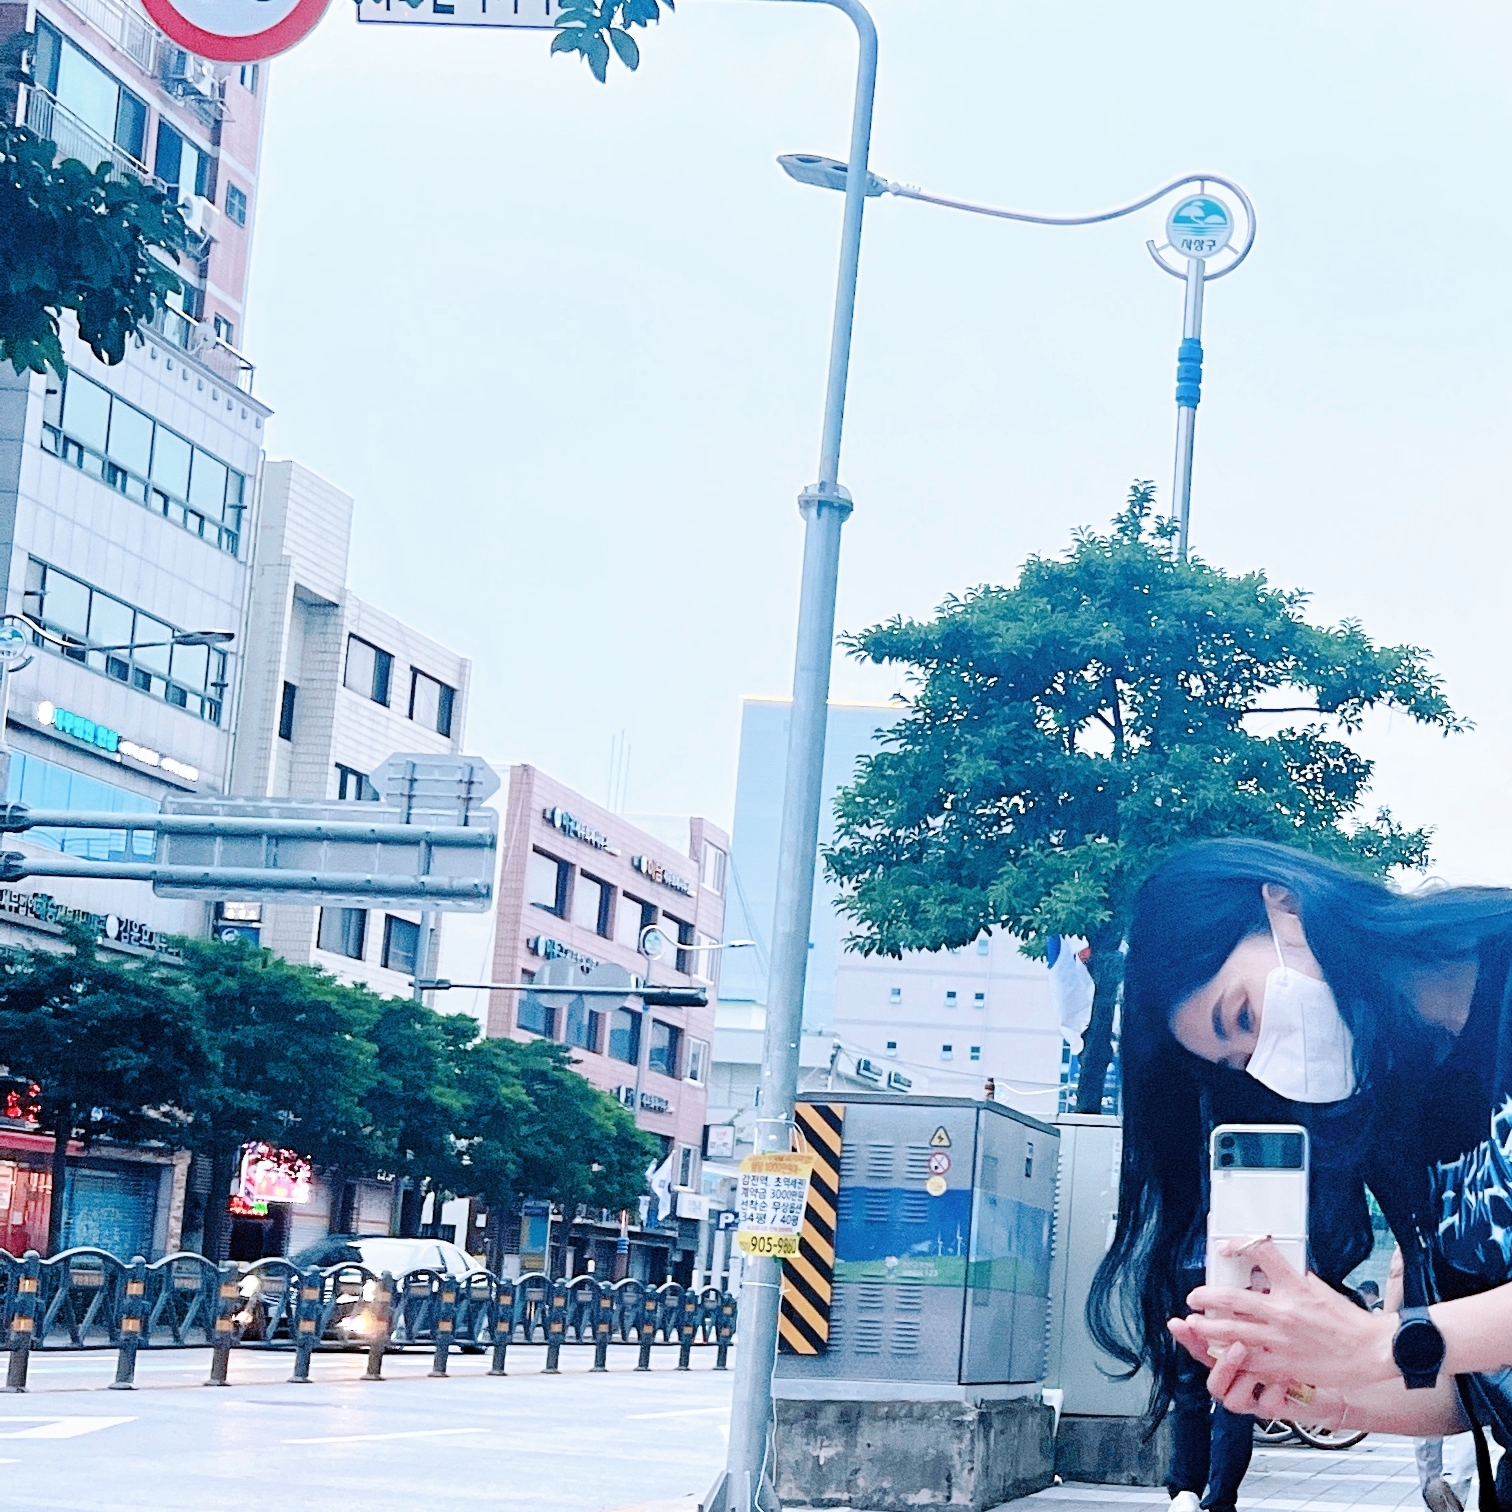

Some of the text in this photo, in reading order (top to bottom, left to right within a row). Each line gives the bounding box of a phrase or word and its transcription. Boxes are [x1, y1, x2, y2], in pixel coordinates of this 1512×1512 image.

[742, 1174, 768, 1187] 감전역
[741, 1187, 767, 1199] 계약금
[741, 1199, 768, 1211] 선착순
[741, 1212, 767, 1225] 34평
[780, 1214, 799, 1227] 40평
